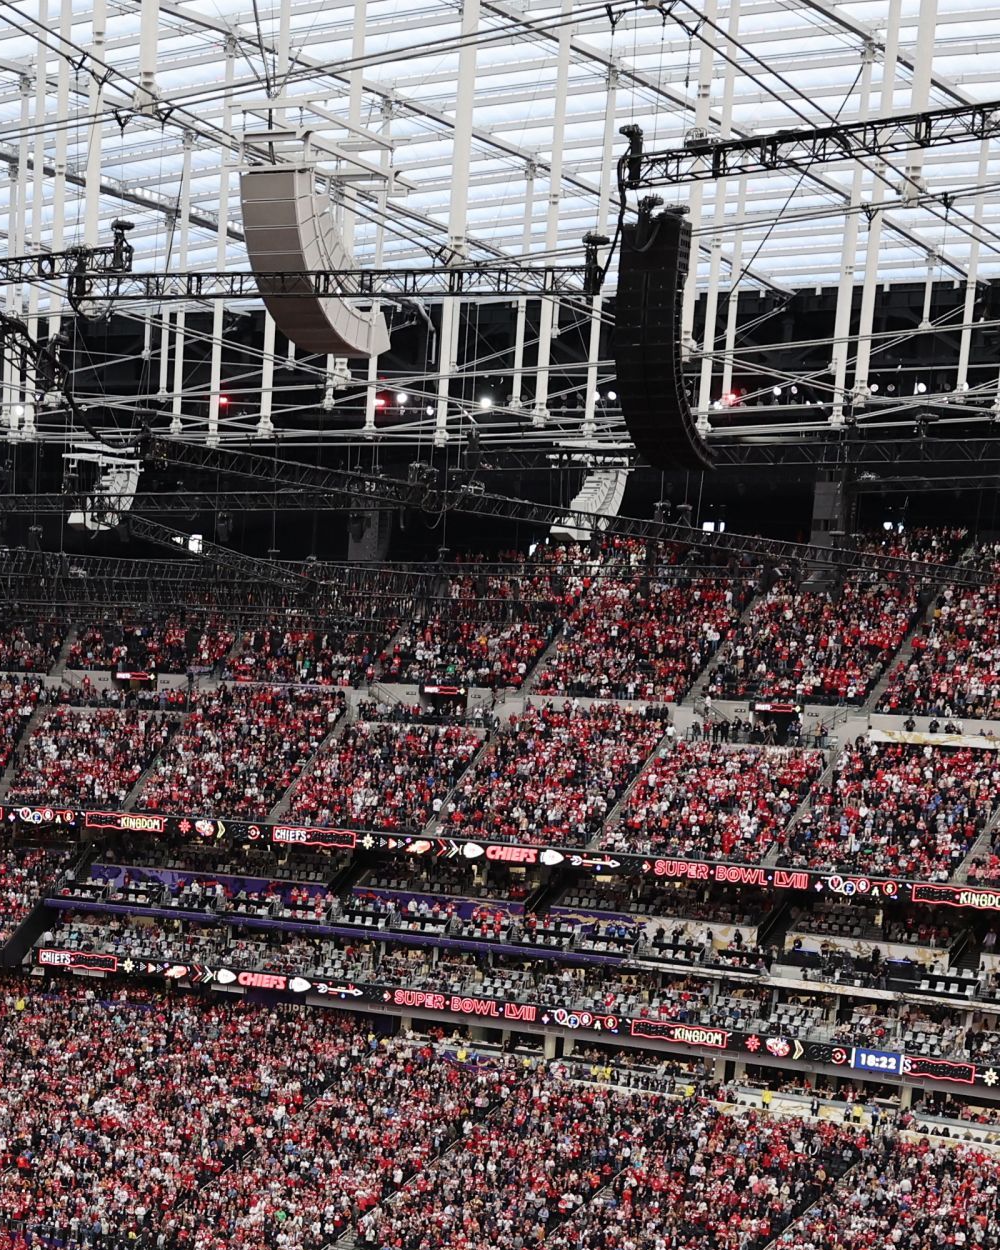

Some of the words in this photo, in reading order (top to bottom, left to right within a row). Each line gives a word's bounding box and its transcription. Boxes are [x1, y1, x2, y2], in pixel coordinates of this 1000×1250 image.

[120, 816, 160, 830] KINGDOM
[275, 828, 307, 842] CHIEFS
[486, 845, 539, 863] CHIEFS
[654, 859, 709, 879] SUPER
[715, 865, 768, 885] BOWL
[773, 870, 808, 890] LVIII
[41, 950, 71, 964] CHIEFS
[238, 972, 287, 989] CHIEFS
[394, 989, 445, 1009] SUPER
[451, 996, 499, 1017] BOWL
[504, 1002, 536, 1021] LVIII
[674, 1026, 722, 1045] KINGDOM
[860, 1053, 896, 1069] 18:22
